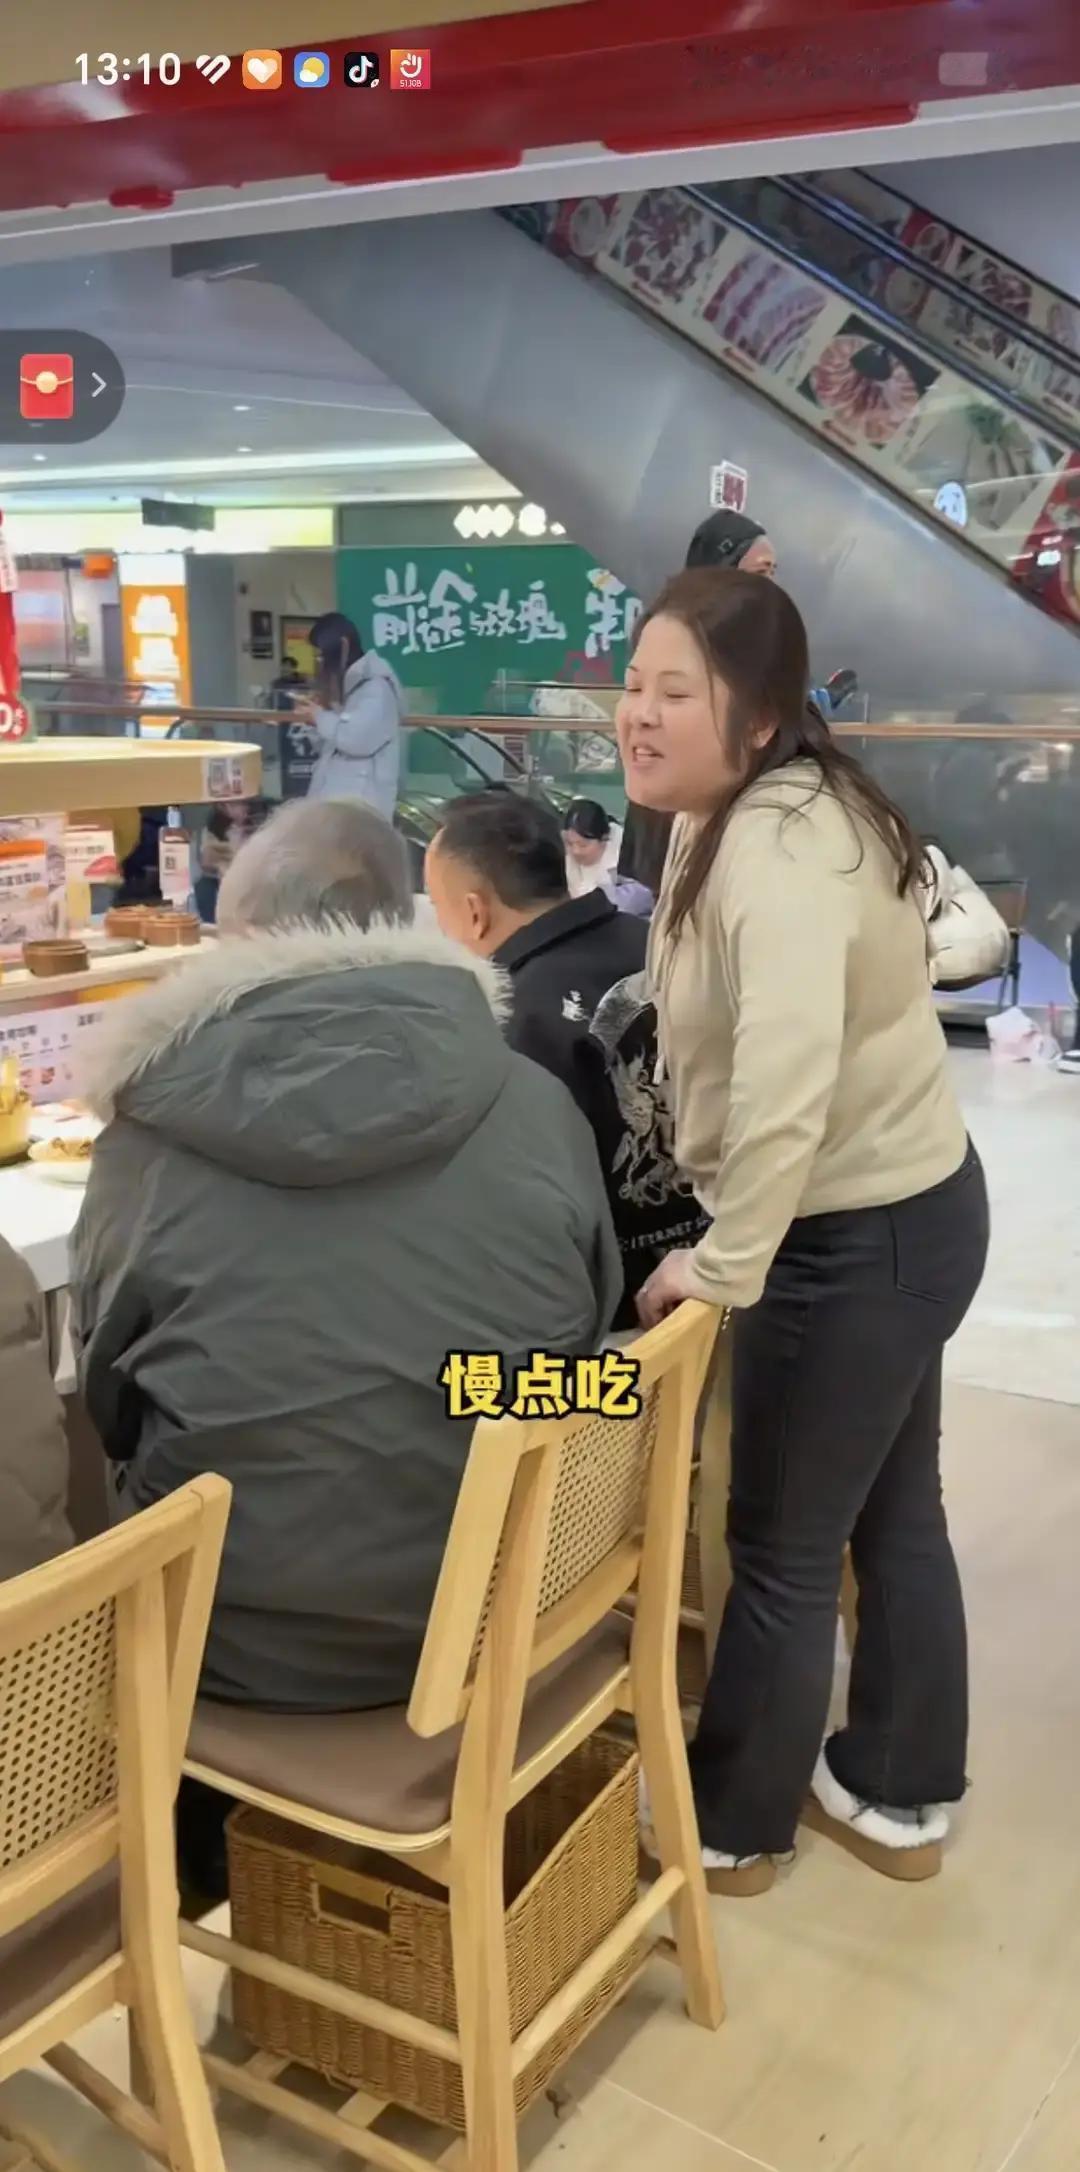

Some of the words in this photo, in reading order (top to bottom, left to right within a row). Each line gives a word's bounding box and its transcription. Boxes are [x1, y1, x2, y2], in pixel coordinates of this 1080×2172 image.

[372, 562, 566, 654] 前途与玫瑰
